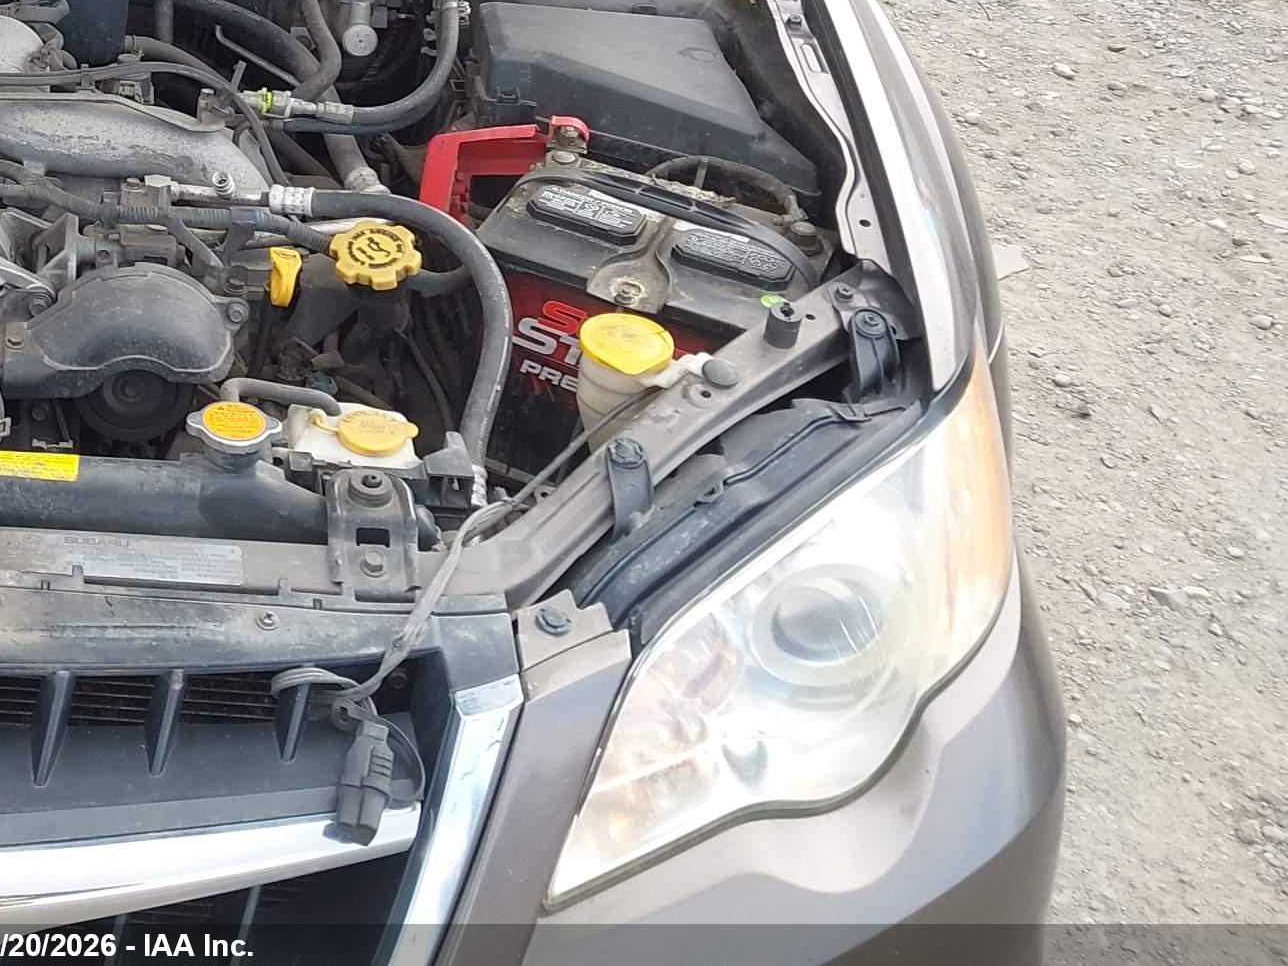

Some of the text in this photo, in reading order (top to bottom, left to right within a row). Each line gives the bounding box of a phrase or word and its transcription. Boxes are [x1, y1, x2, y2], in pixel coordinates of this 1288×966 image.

[542, 300, 588, 336] S
[519, 358, 579, 393] PRE
[63, 536, 130, 548] SUBARU
